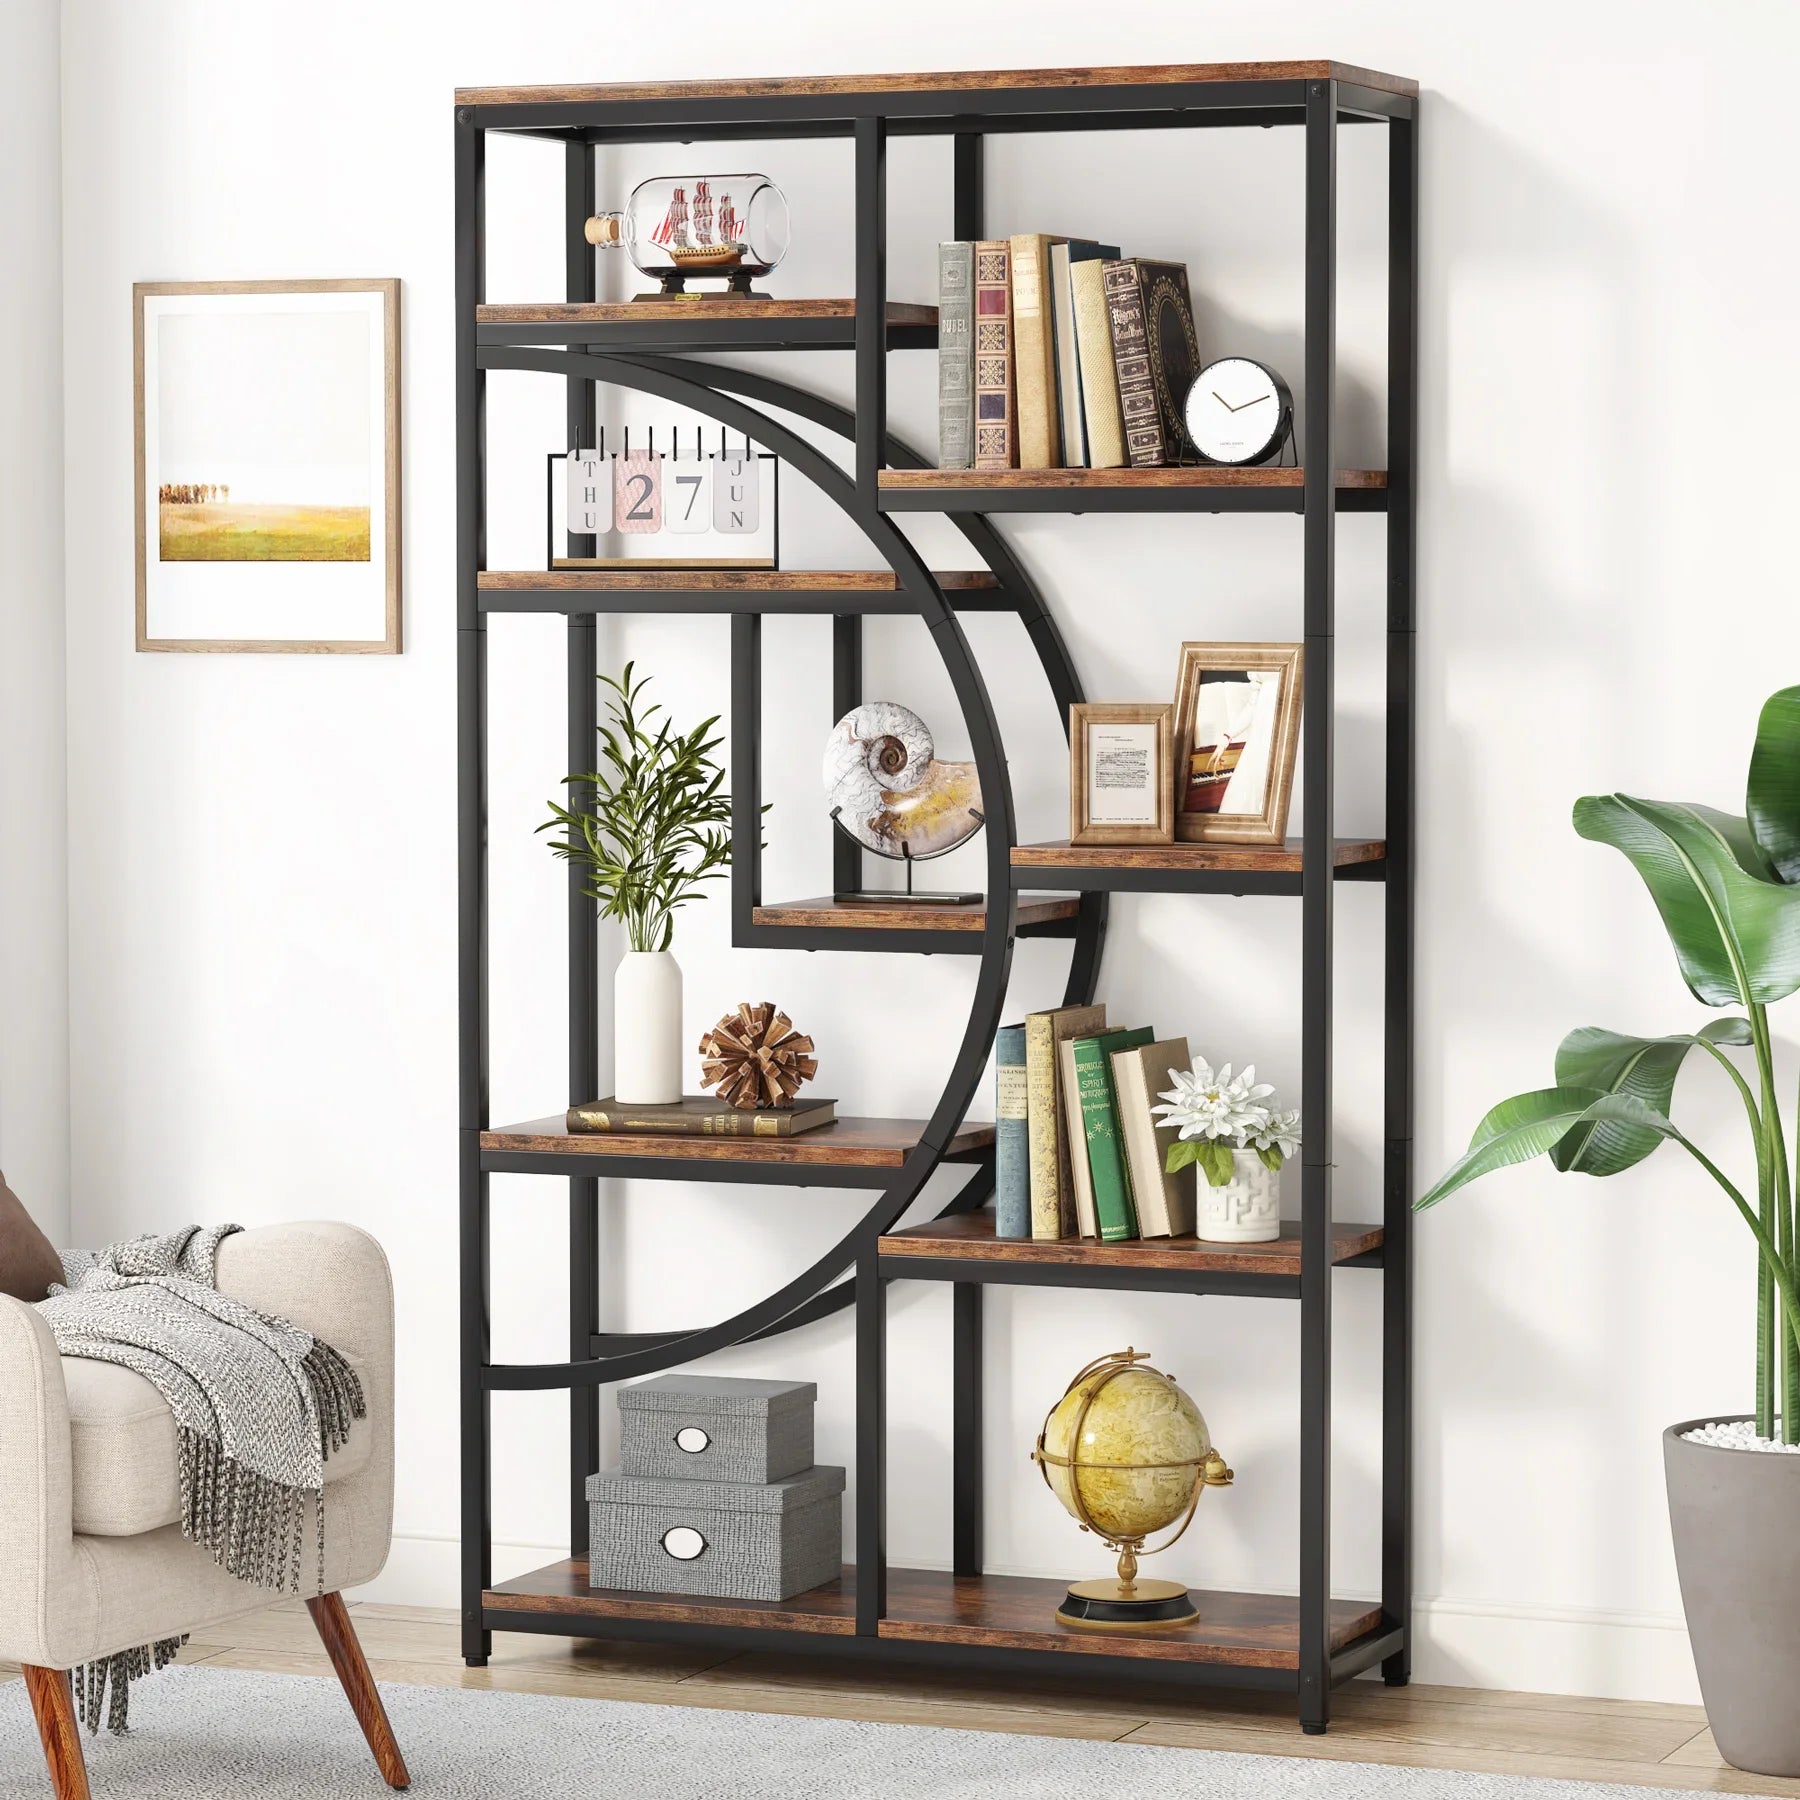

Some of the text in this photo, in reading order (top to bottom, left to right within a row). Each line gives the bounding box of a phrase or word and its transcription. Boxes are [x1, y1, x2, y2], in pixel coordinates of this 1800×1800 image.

[583, 461, 597, 529] THU
[730, 460, 744, 528] JUN
[1082, 1078, 1105, 1088] SPIRIT
